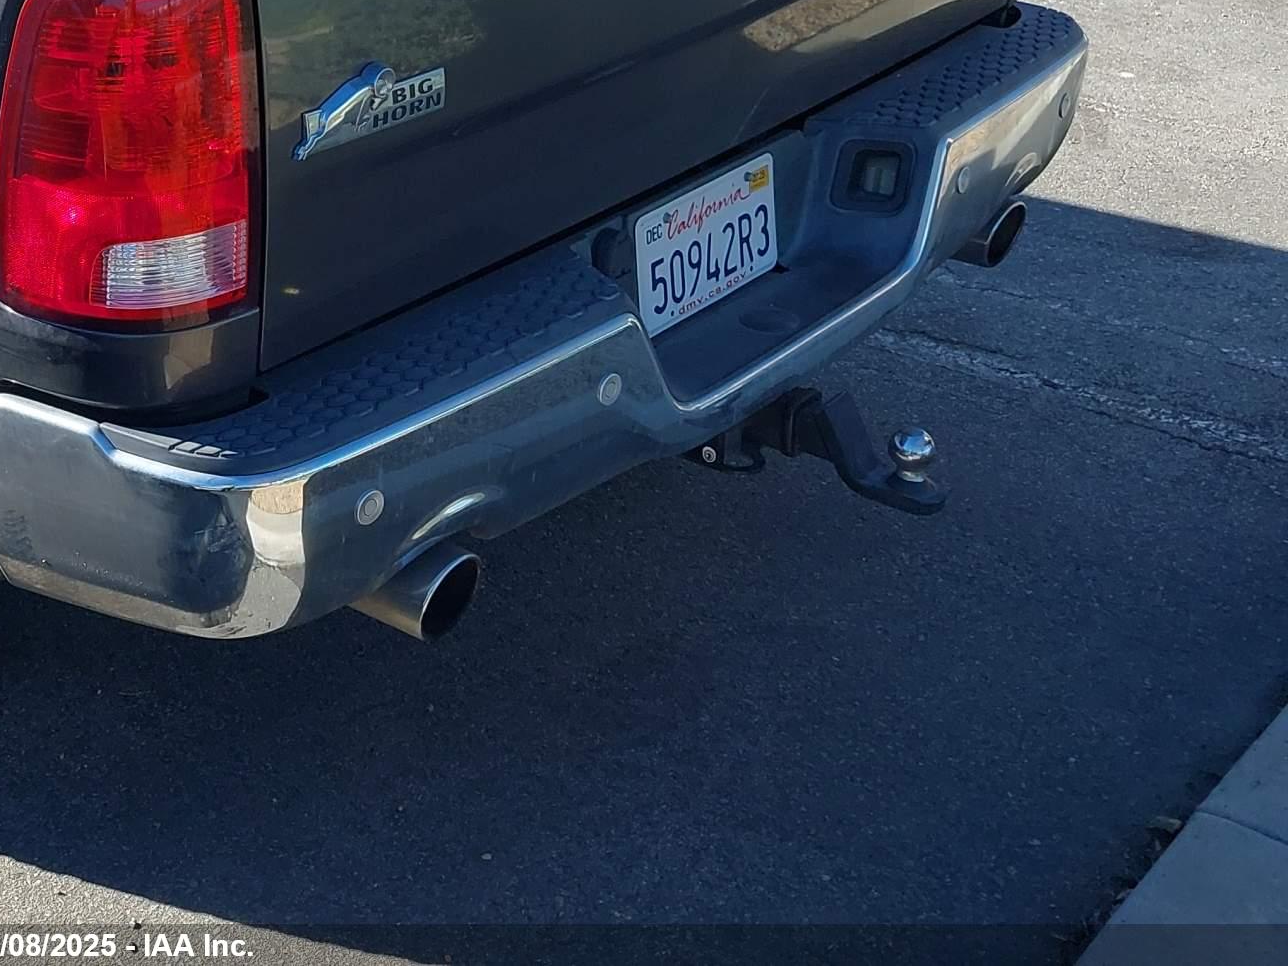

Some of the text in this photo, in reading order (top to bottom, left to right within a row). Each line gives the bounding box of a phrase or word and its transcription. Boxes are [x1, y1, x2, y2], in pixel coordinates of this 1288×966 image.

[372, 92, 442, 129] HORN
[391, 77, 433, 105] BIG
[646, 185, 751, 245] DEC California
[650, 204, 770, 315] 50942R3
[678, 271, 747, 315] dmv.ca.gov
